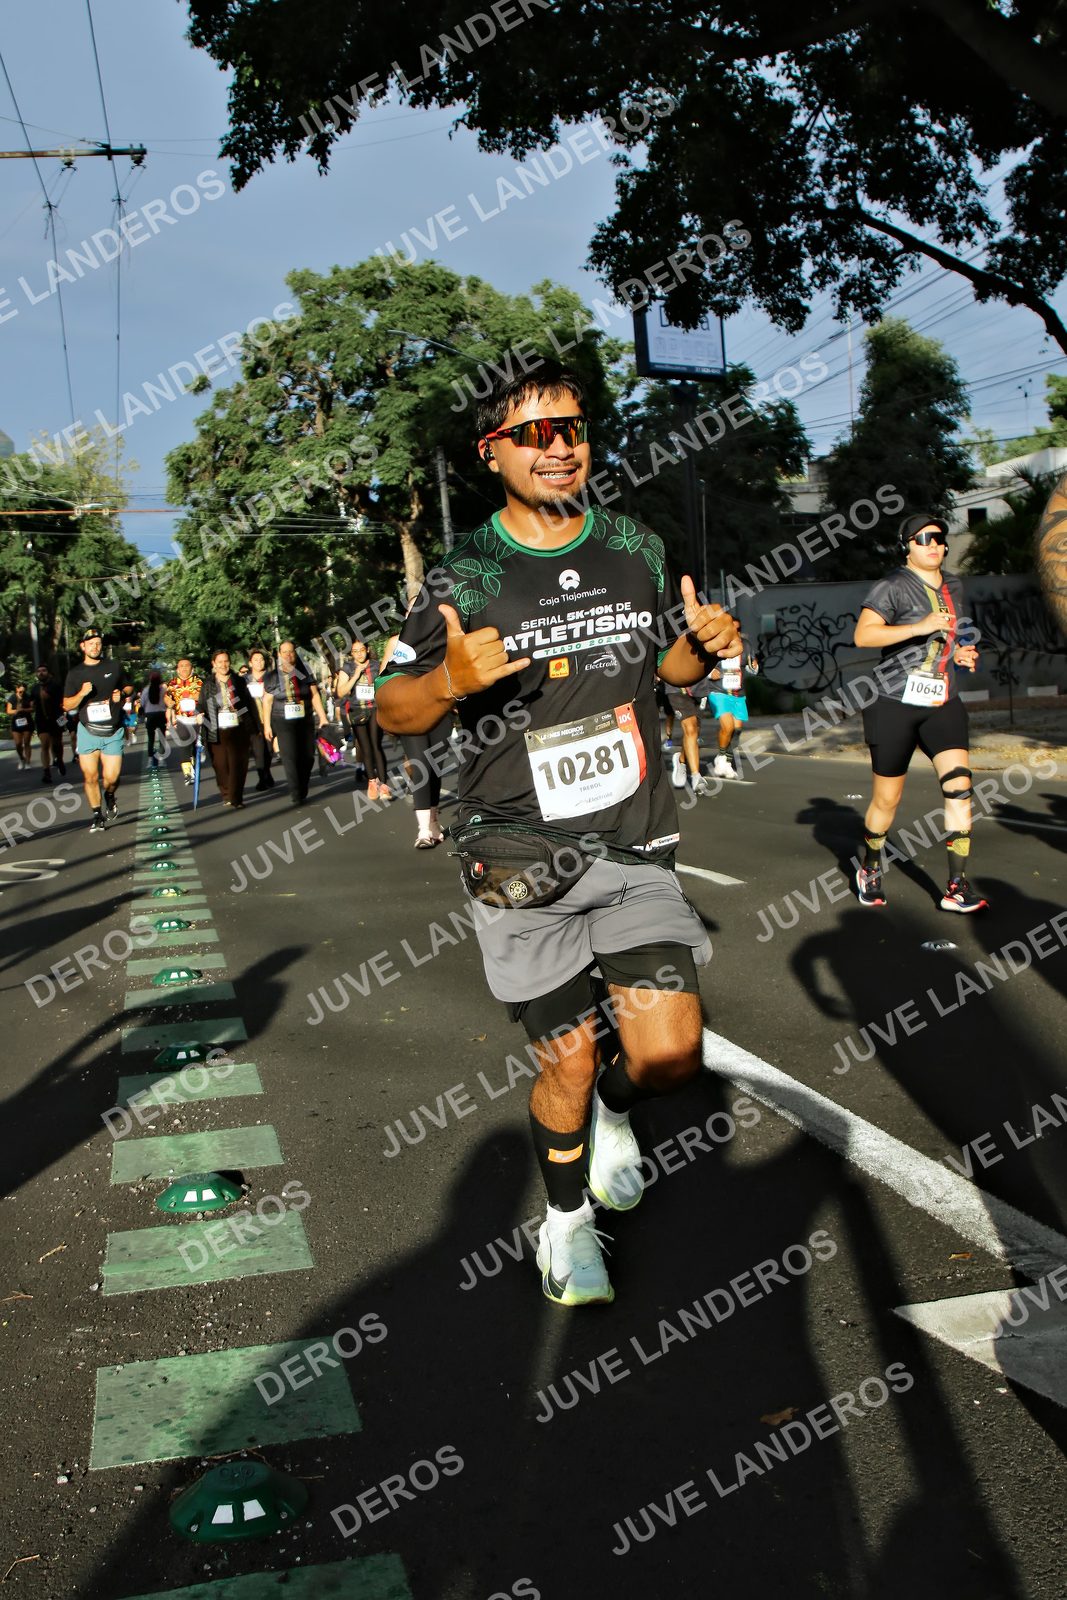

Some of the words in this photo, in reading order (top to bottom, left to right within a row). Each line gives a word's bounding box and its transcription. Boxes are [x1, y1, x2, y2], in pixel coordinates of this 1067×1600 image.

[539, 597, 560, 606] Caja
[561, 587, 607, 601] Tlajomulco
[521, 614, 564, 631] SERIAL
[566, 603, 614, 621] 5K-10K
[616, 602, 631, 612] DE
[776, 602, 816, 617] TOY
[502, 611, 653, 652] ATLETISMO
[544, 643, 582, 655] TLAJO
[910, 681, 944, 696] 10642
[537, 739, 630, 790] 10281
[579, 782, 602, 793] TREBOL
